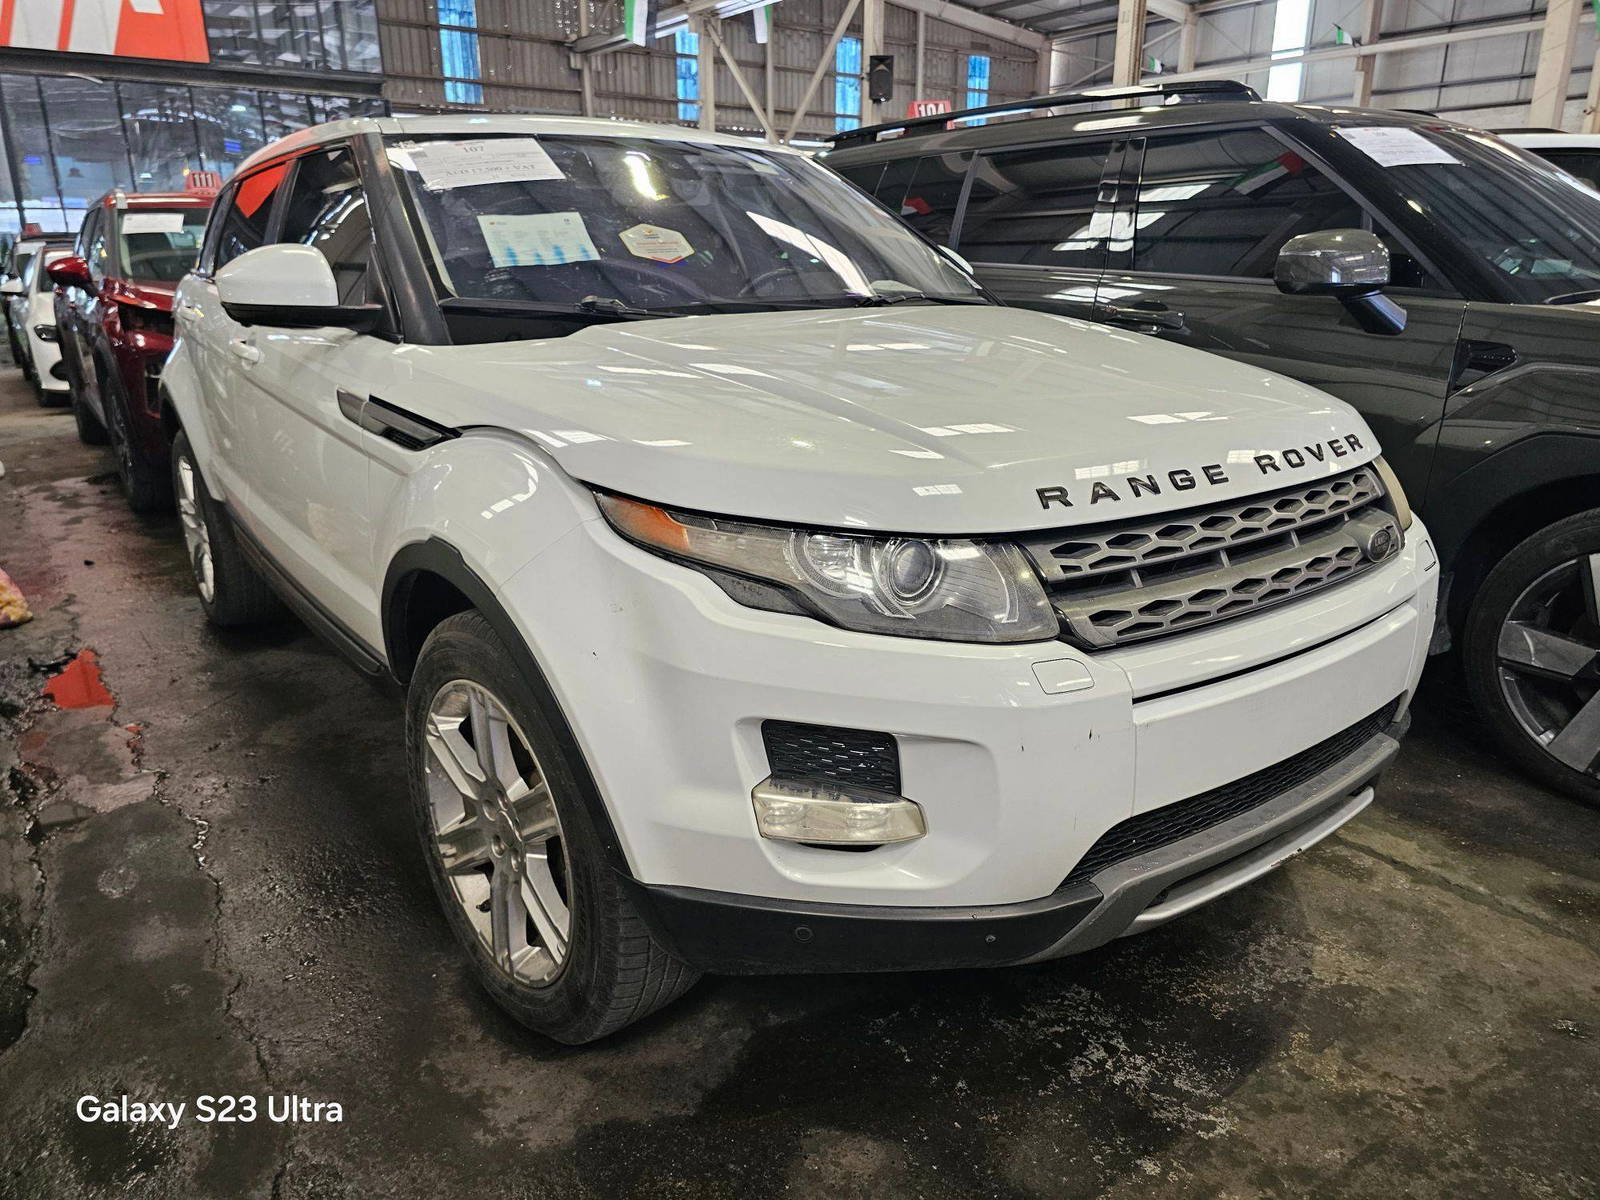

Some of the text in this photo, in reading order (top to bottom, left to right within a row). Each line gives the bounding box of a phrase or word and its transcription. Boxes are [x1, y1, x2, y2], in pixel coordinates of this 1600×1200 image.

[193, 173, 214, 188] 111
[1036, 433, 1364, 510] RANGE ROVER
